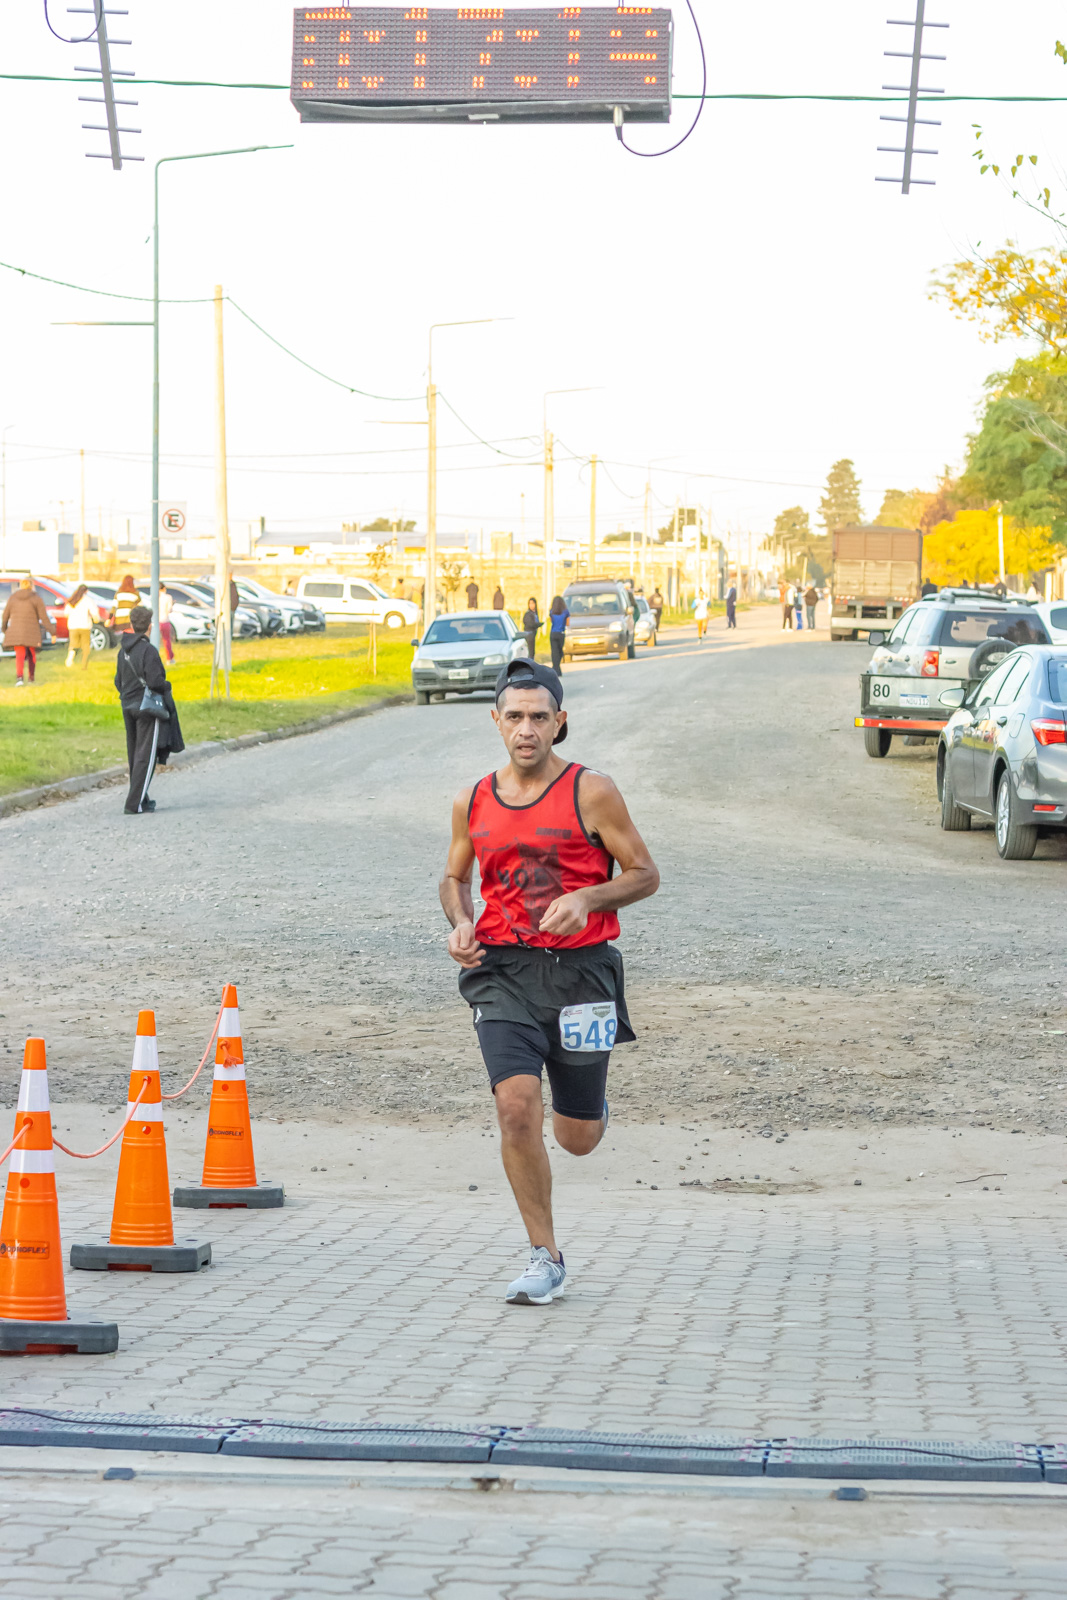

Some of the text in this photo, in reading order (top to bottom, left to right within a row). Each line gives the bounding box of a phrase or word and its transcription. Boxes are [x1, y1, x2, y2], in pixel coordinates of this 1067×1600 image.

[168, 513, 179, 527] E
[873, 684, 890, 698] 80
[563, 1018, 616, 1049] 548
